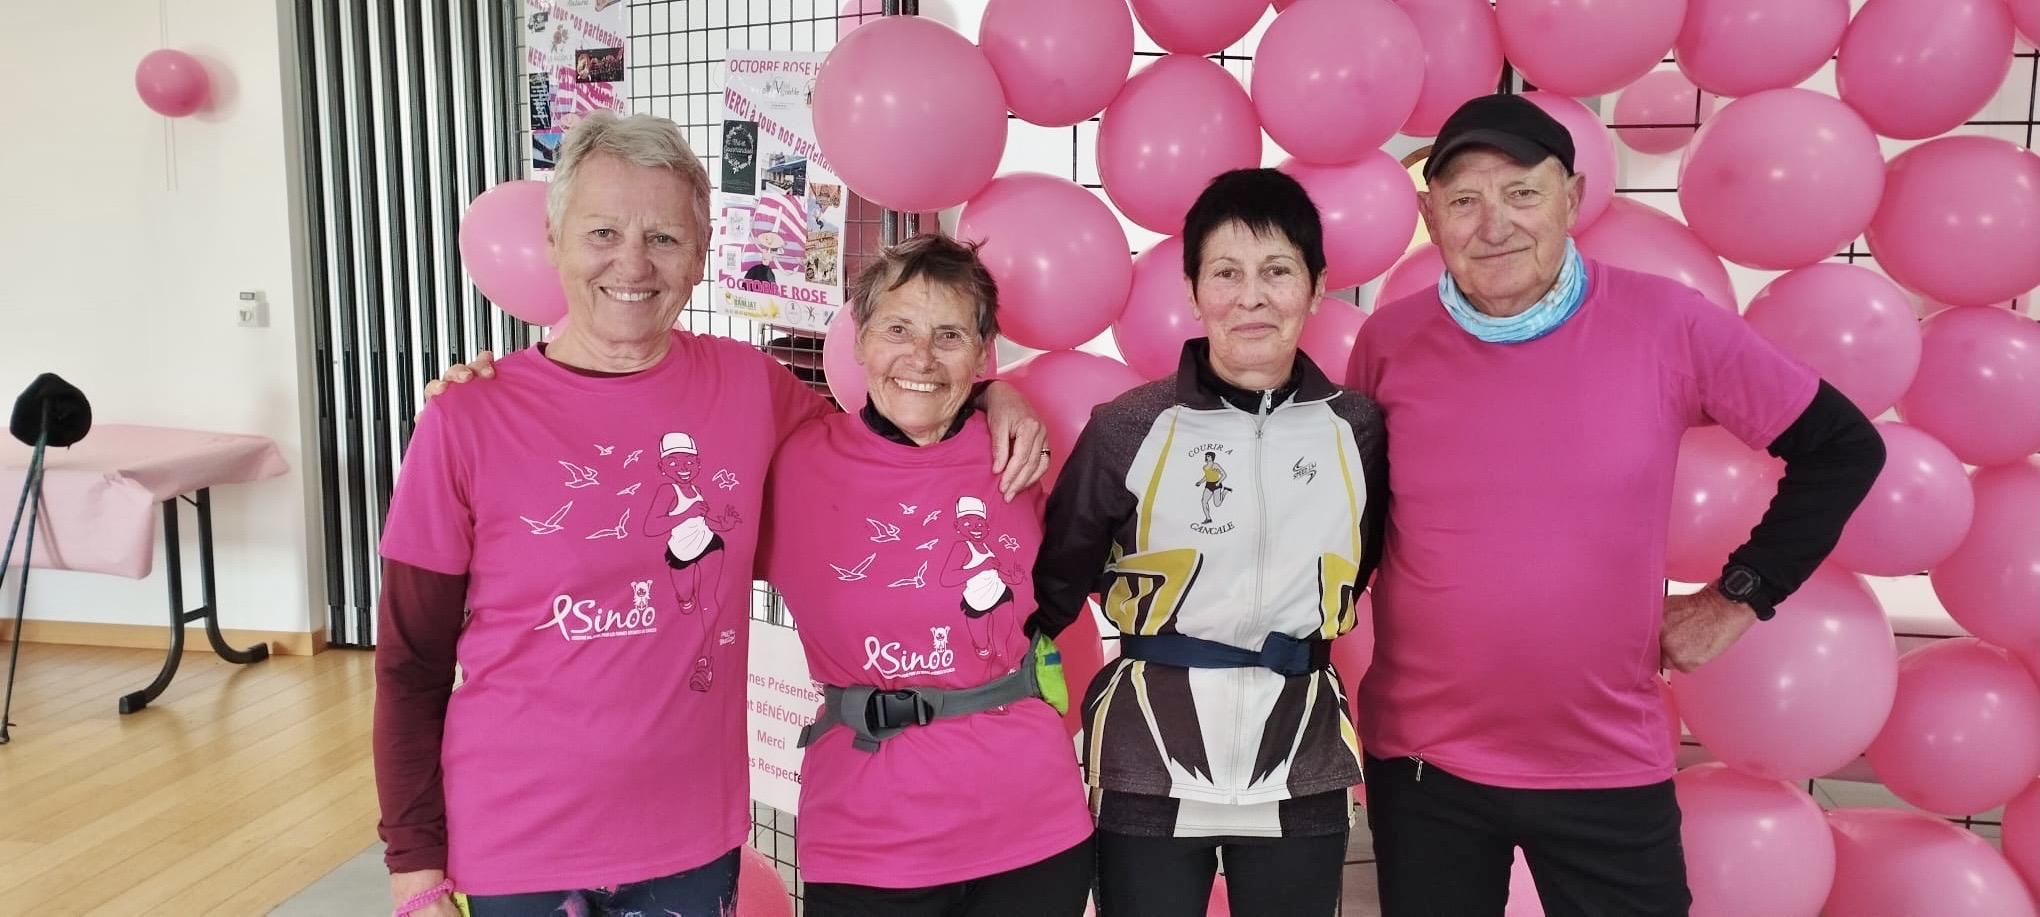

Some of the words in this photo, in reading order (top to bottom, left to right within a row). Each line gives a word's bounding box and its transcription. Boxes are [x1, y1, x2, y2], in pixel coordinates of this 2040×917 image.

[730, 59, 780, 74] OCTOBRE
[782, 61, 812, 76] ROSE
[724, 87, 751, 119] MERCI
[777, 126, 795, 148] nos
[726, 277, 788, 299] OCTOBRE
[791, 286, 828, 305] ROSE
[1187, 442, 1224, 459] COURIR
[570, 599, 656, 634] Sinoo
[880, 641, 954, 675] Sinoo
[749, 672, 766, 688] nes
[767, 676, 820, 703] Présentes
[756, 698, 816, 729] BÉNÉVOLES
[756, 728, 786, 750] Merci
[758, 756, 803, 785] Respecte
